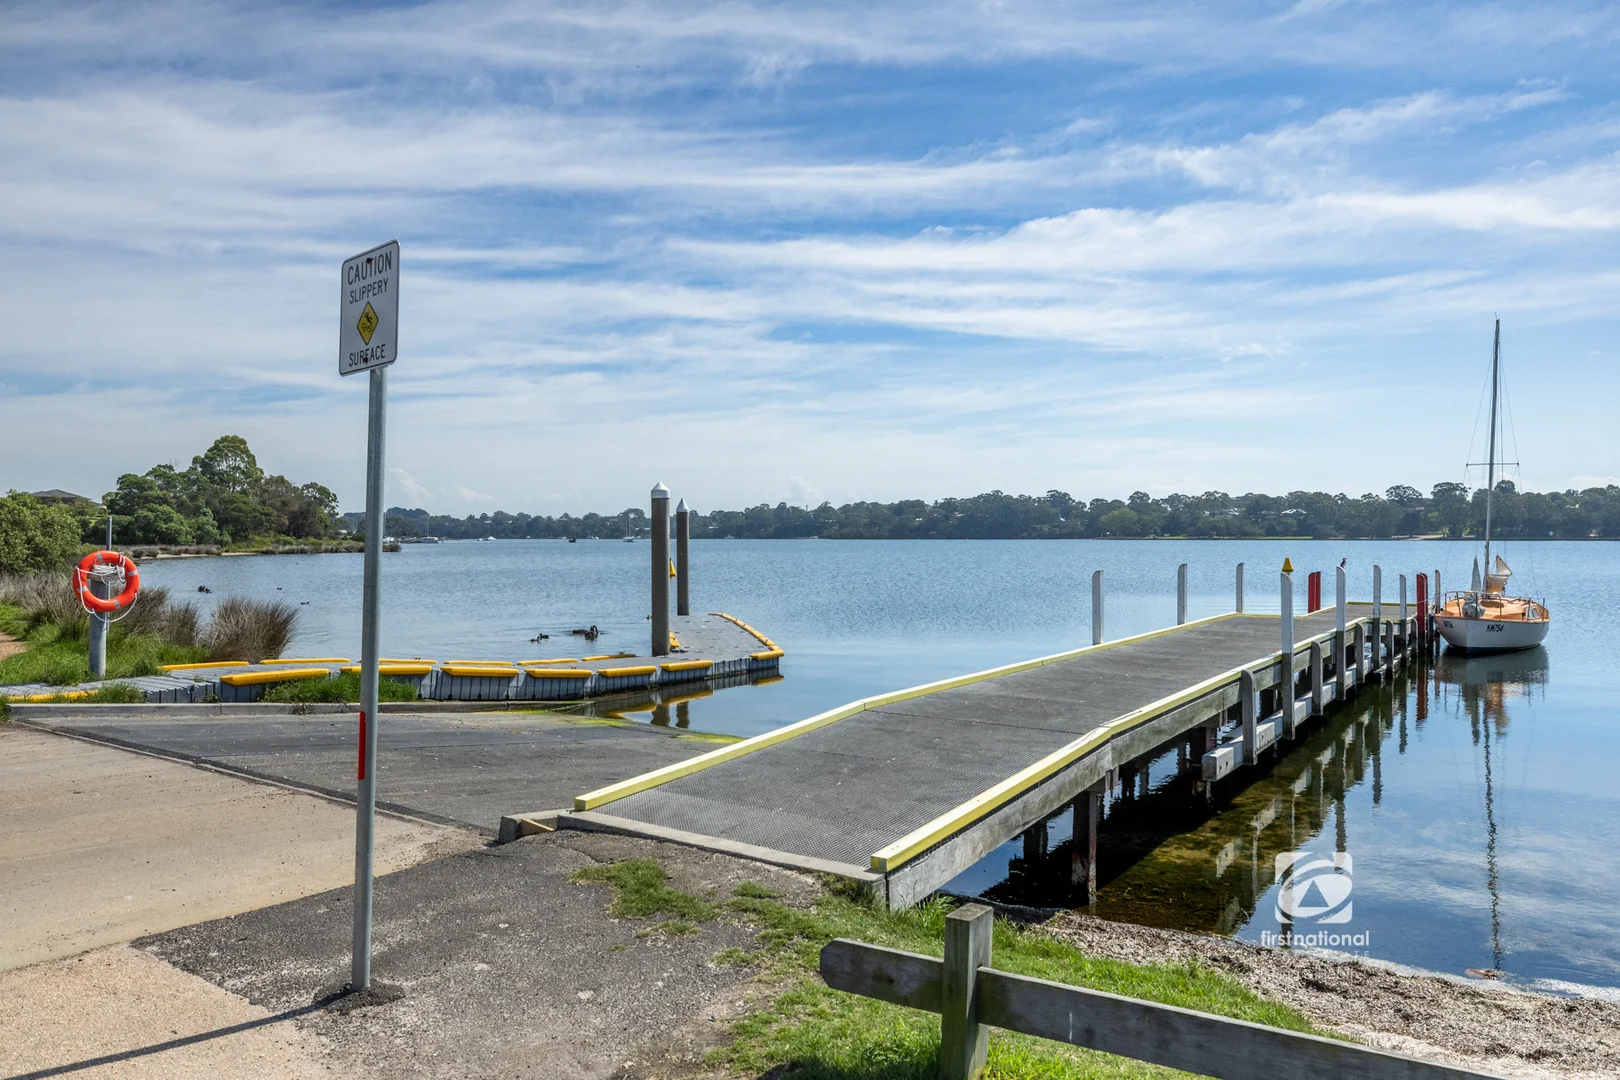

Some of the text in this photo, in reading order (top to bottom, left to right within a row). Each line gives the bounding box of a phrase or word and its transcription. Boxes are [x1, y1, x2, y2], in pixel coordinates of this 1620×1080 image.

[347, 250, 392, 285] CAUTION
[349, 277, 389, 304] SLIPPERY
[348, 344, 386, 367] SURFACE
